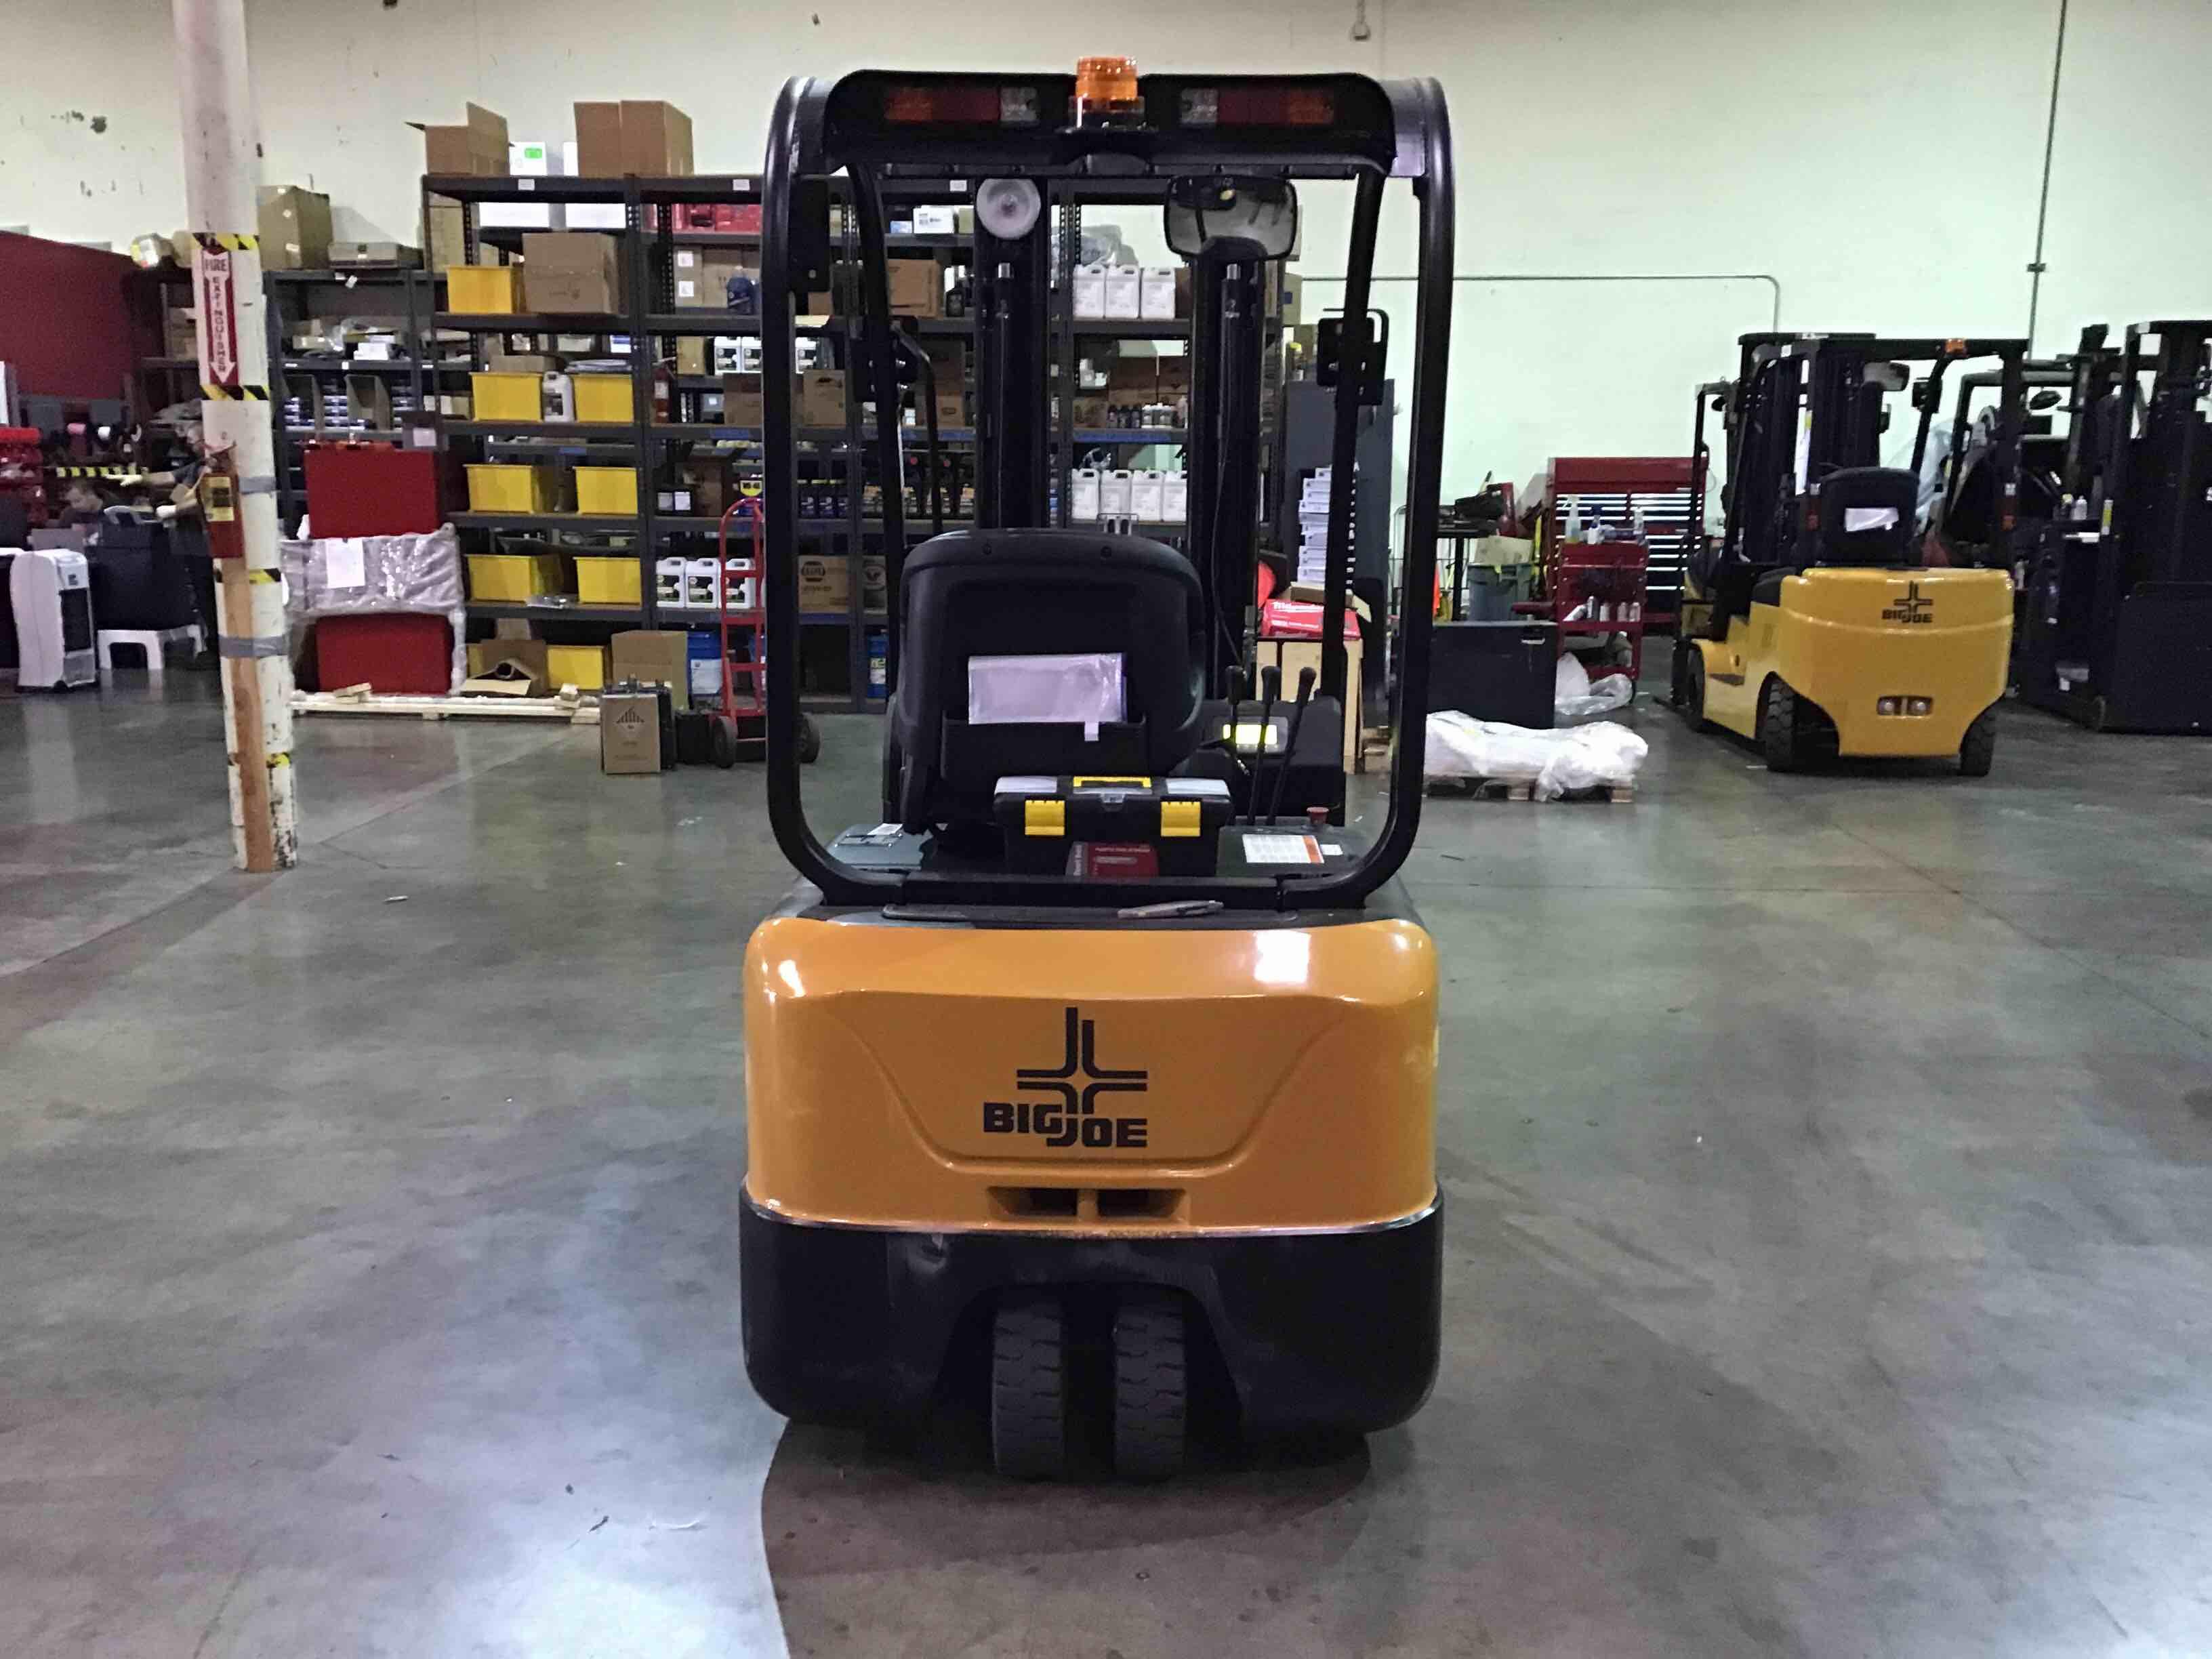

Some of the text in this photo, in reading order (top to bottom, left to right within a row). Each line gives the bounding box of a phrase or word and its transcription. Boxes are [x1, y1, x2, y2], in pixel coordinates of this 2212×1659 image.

[205, 259, 227, 272] FIRE
[983, 1102, 1148, 1147] BIG JOE
